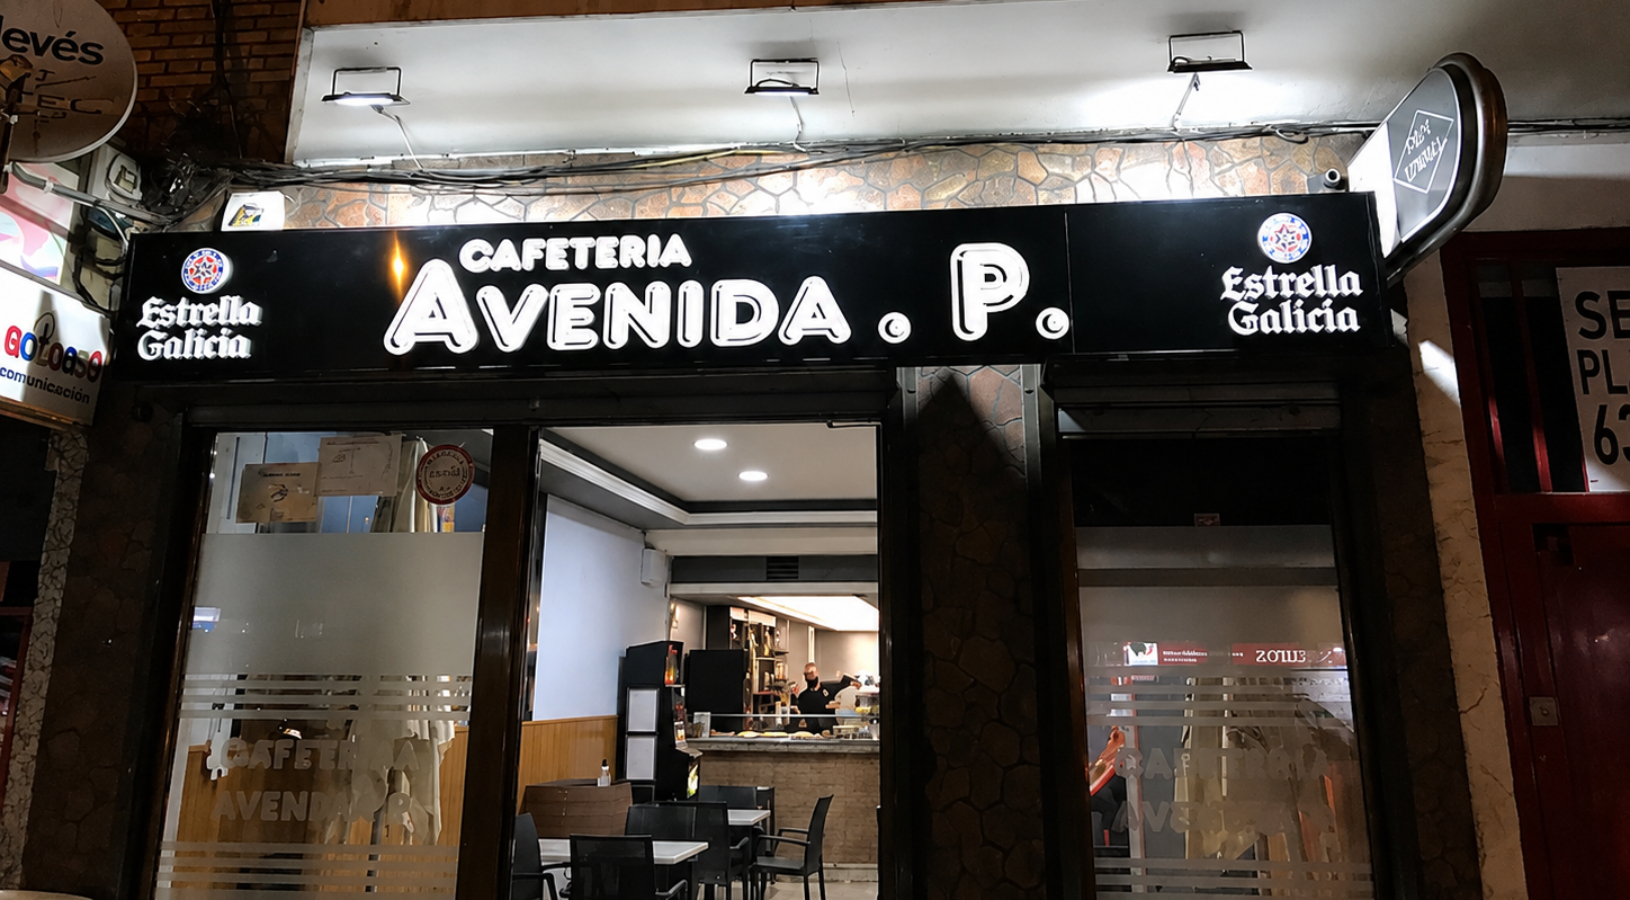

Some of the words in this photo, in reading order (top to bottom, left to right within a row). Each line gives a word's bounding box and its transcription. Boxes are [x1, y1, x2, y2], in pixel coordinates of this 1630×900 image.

[459, 233, 692, 273] CAFETERIA
[1220, 264, 1363, 300] Estrella
[136, 295, 262, 328] Estrella
[383, 258, 851, 356] AVENIDA
[1228, 298, 1361, 336] Galicia
[137, 327, 252, 361] Galicia
[0, 367, 90, 404] comunicación
[1577, 350, 1630, 395] PL
